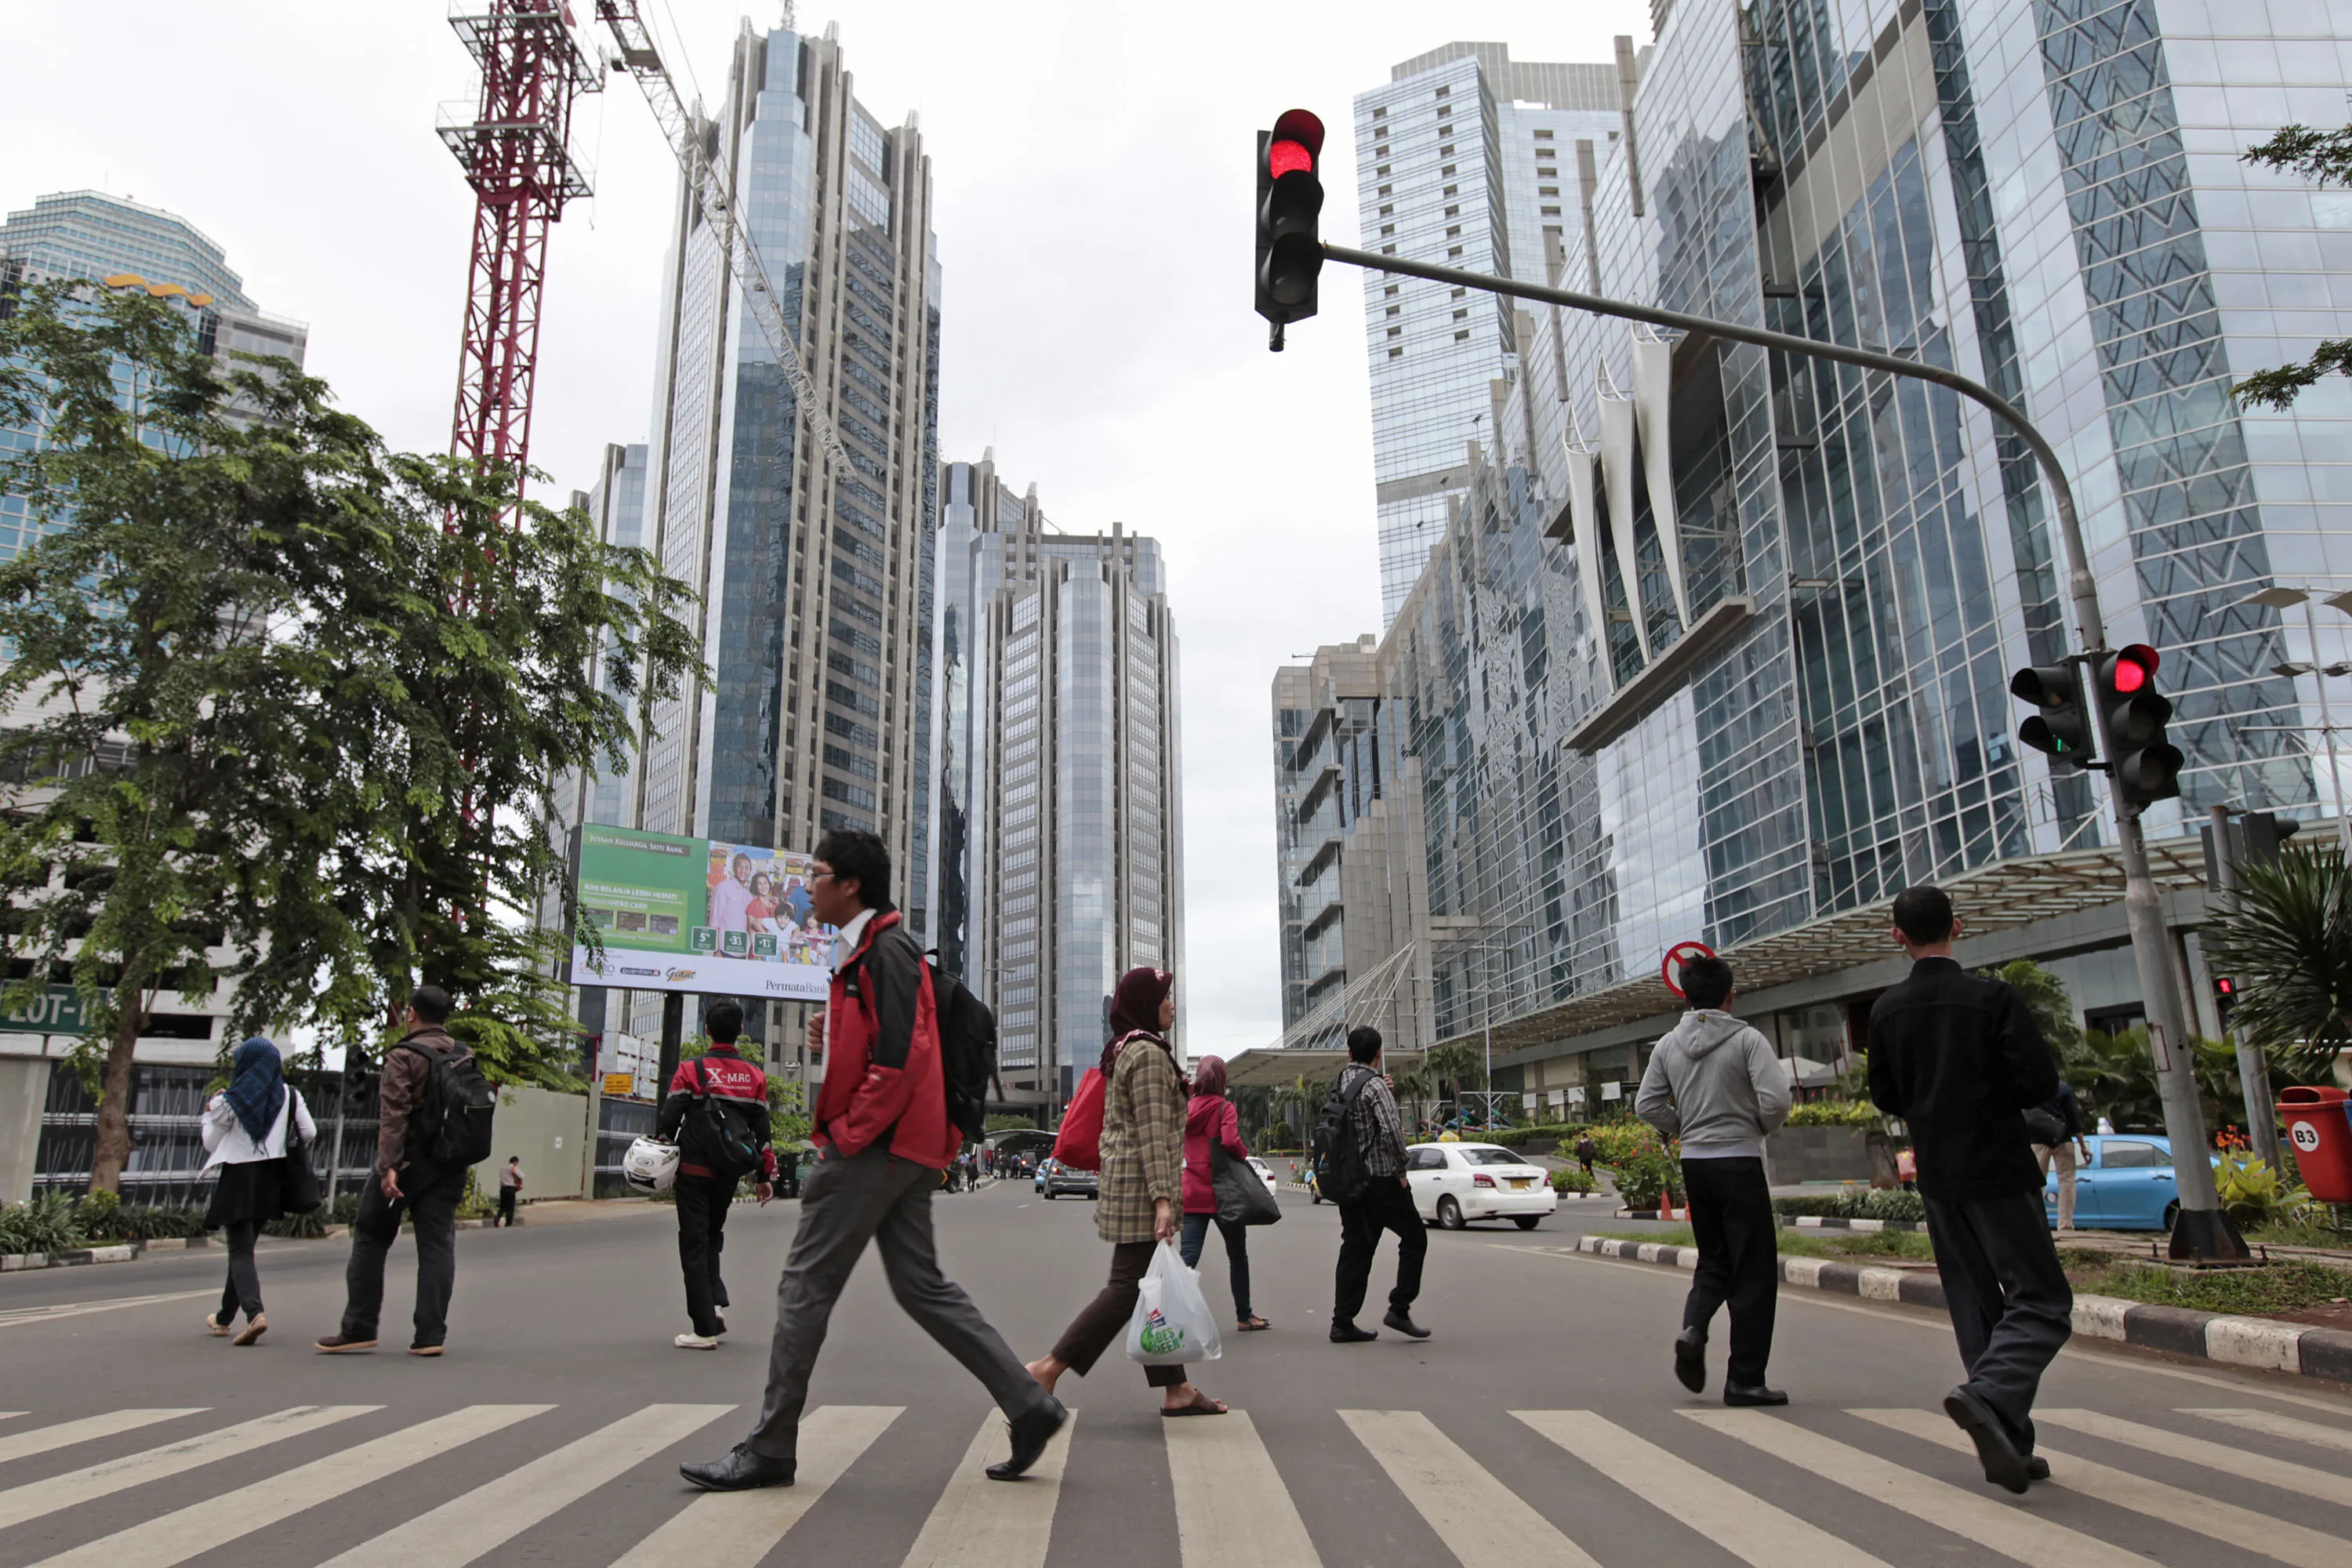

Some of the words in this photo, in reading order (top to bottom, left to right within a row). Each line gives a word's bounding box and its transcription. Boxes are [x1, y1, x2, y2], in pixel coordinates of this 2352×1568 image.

[600, 884, 630, 895] BELANJA
[666, 967, 696, 982] Giant
[765, 980, 828, 994] PermataBank
[705, 1068, 751, 1084] X-MAC
[2294, 1130, 2316, 1143] B3
